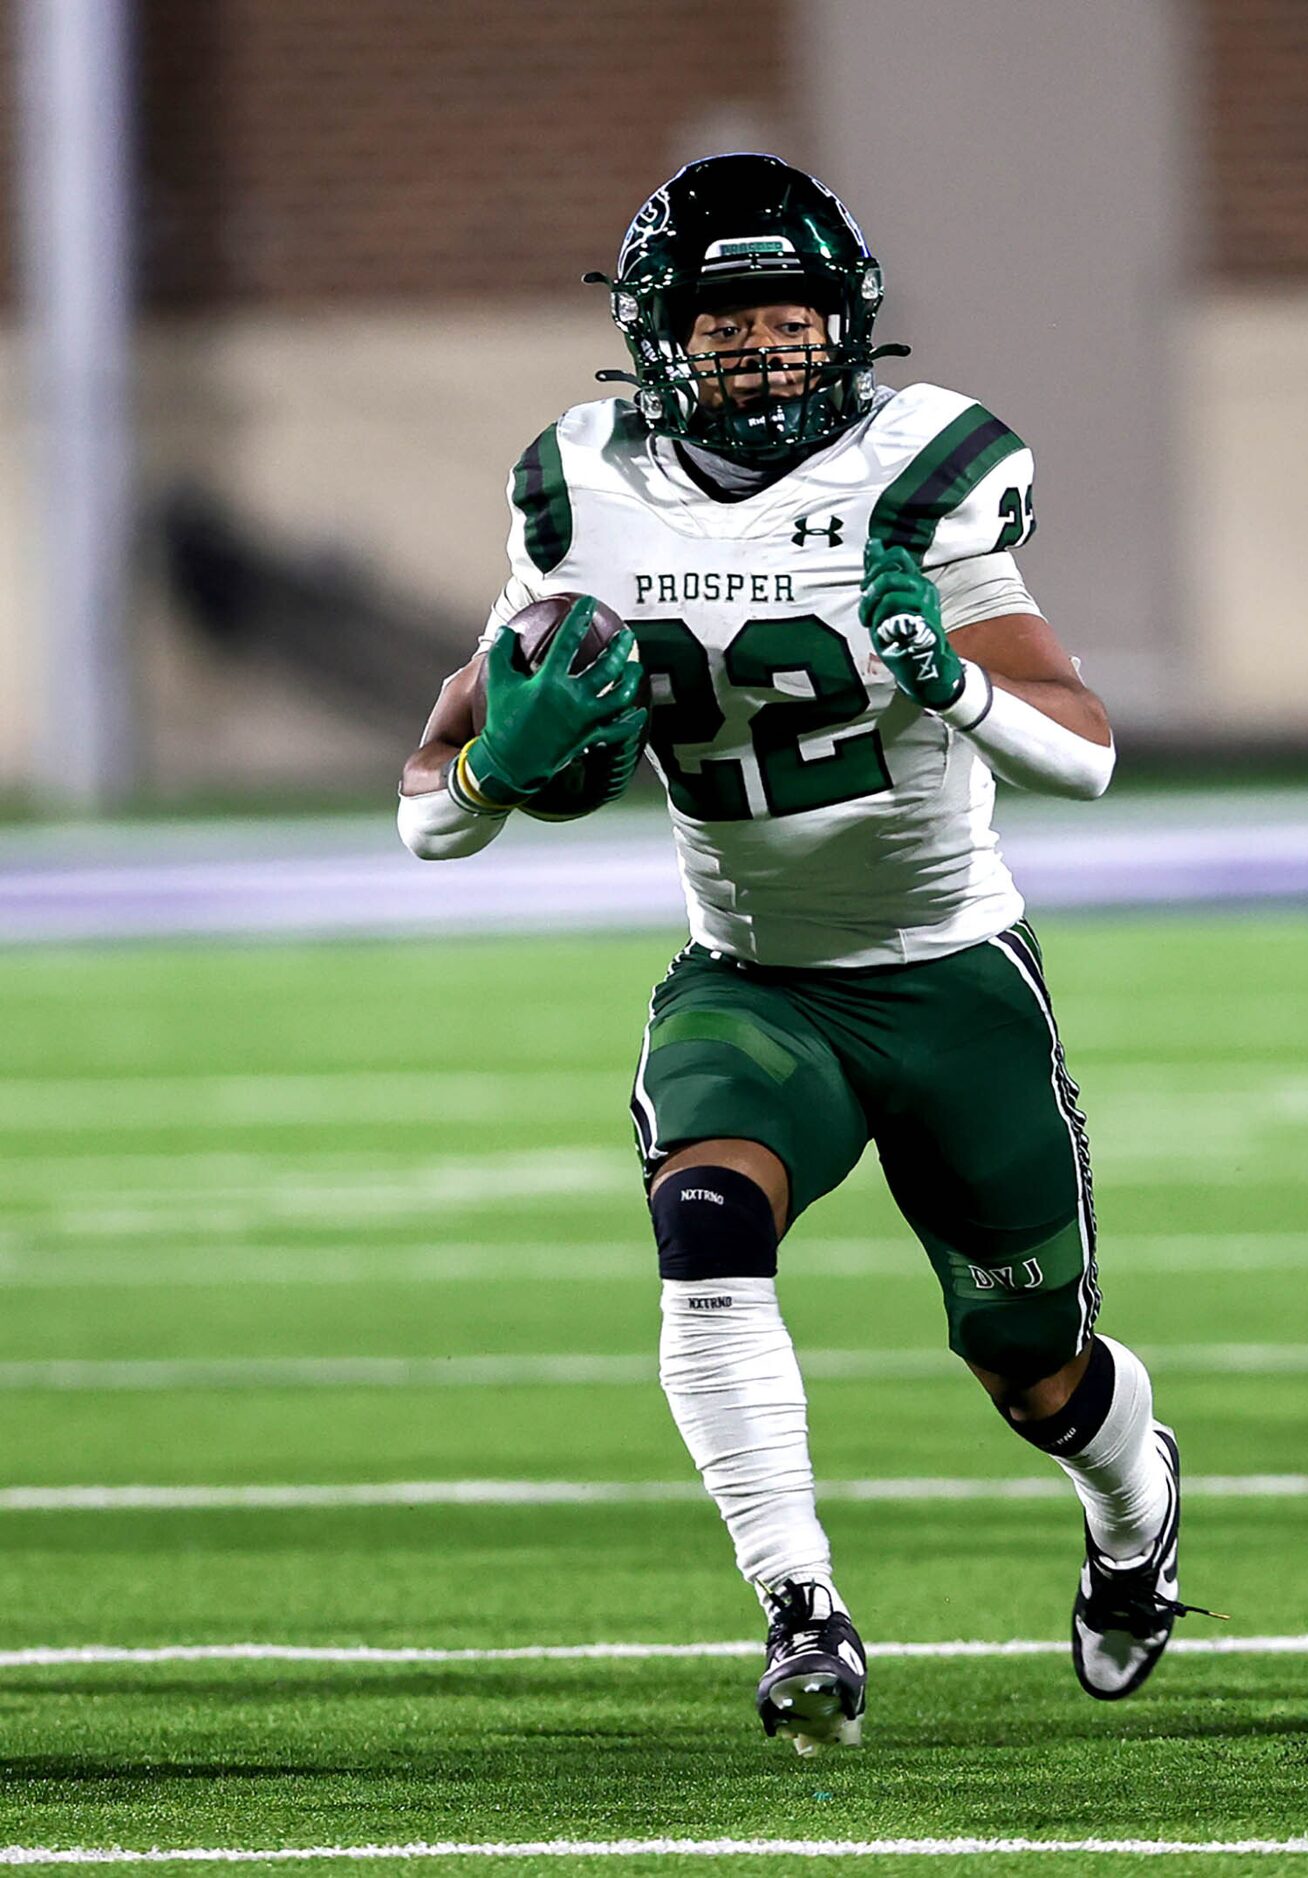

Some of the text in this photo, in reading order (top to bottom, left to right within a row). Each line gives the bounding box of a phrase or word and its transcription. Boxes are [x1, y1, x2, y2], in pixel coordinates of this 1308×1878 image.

[635, 572, 796, 605] PROSPER
[620, 613, 895, 823] 22
[687, 1295, 732, 1310] NXTRND
